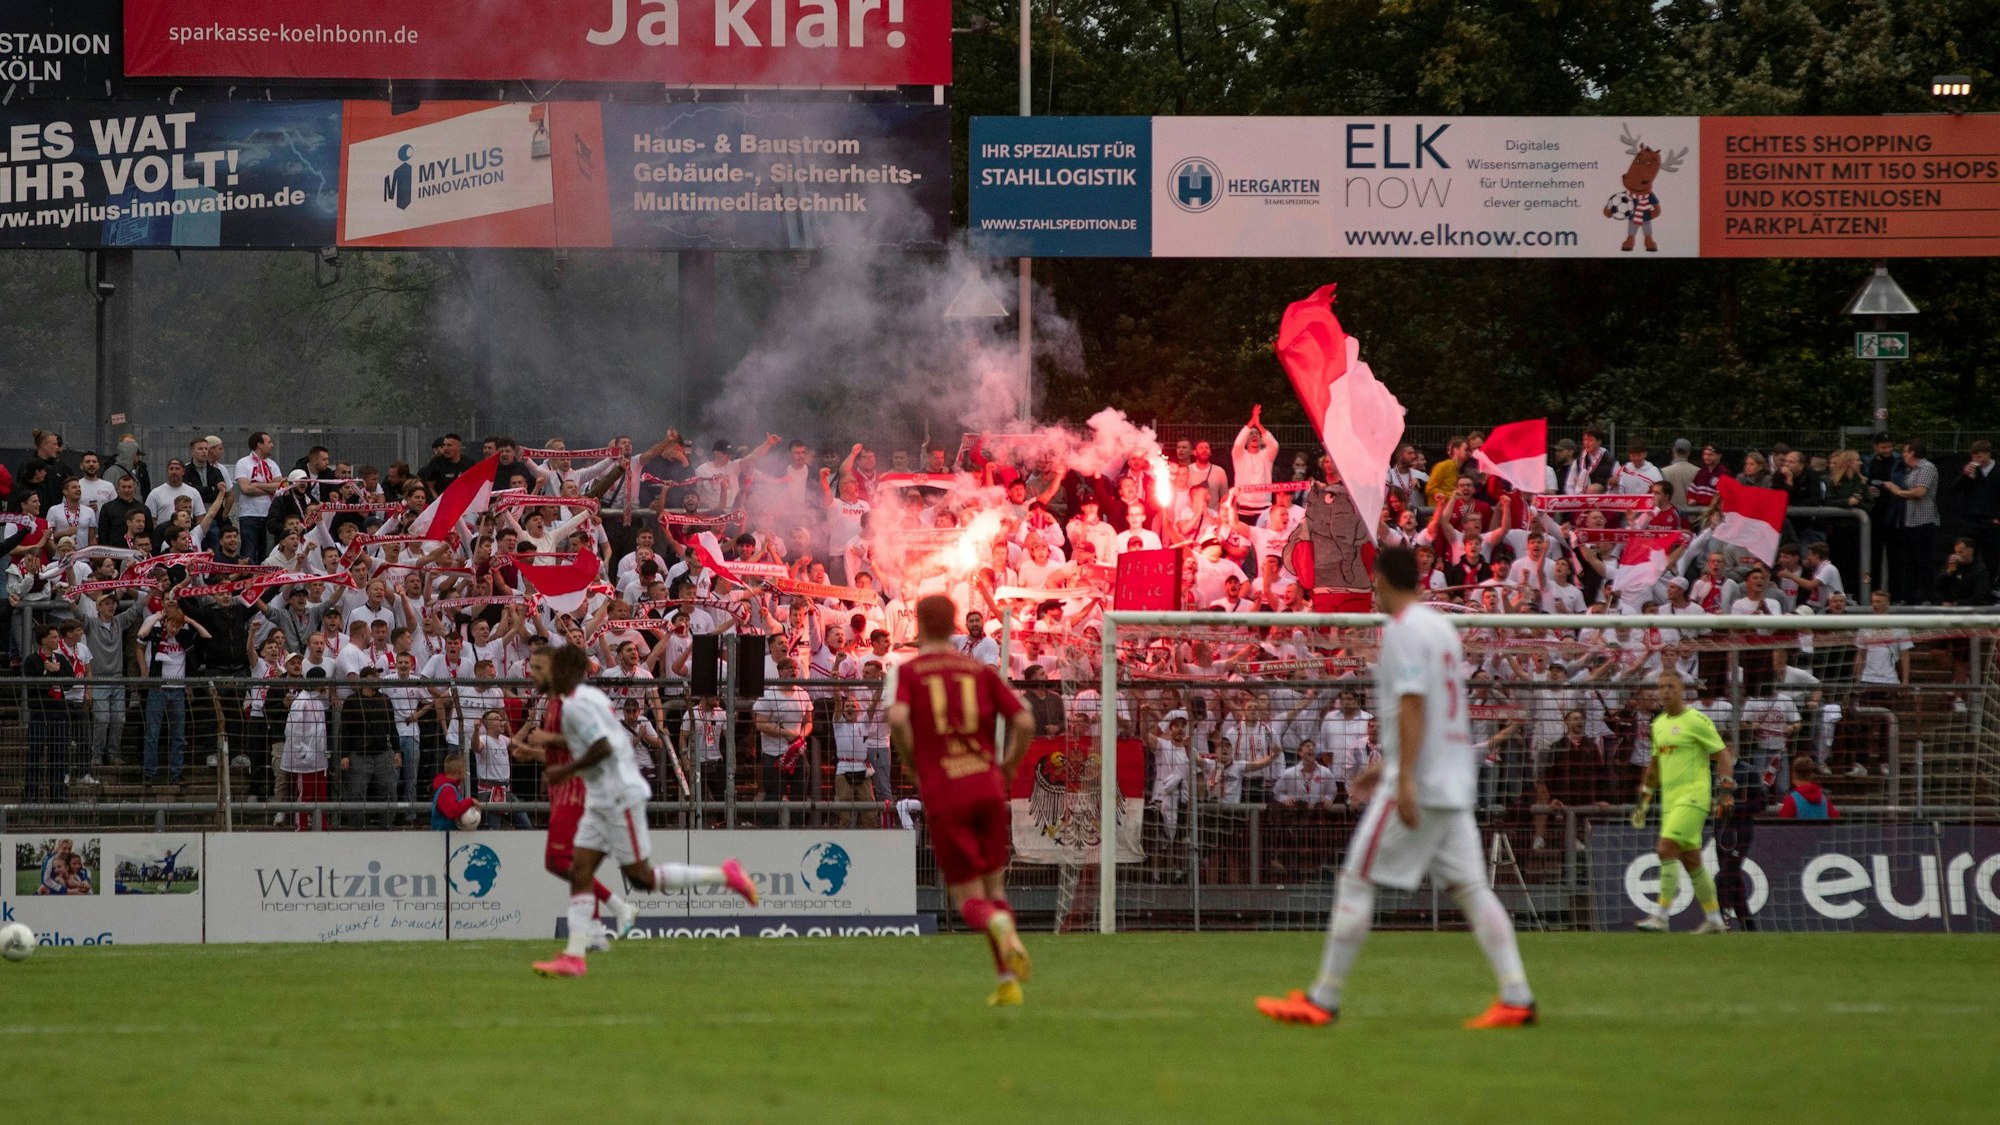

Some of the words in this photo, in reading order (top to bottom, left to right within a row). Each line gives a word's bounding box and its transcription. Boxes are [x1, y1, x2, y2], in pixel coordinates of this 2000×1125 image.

[169, 22, 419, 45] sparkasse-koelnbonn.de
[585, 0, 679, 46] Ja
[714, 0, 906, 48] klar!
[0, 33, 110, 55] STADION
[0, 121, 75, 163] ES
[89, 111, 196, 155] WAT
[634, 134, 705, 153] Haus-
[714, 134, 732, 153] &
[740, 134, 860, 153] Baustrom
[1346, 123, 1452, 169] ELK
[1506, 139, 1560, 153] Digitales
[1726, 135, 1807, 153] ECHTES
[1813, 134, 1932, 152] SHOPPING
[981, 144, 1011, 158] IHR
[1013, 144, 1100, 158] SPEZIALIST
[1104, 141, 1136, 158] FÜR
[419, 147, 504, 183] MYLIUS
[634, 162, 762, 186] Gebäude-,
[770, 163, 922, 184] Sicherheits-
[1466, 158, 1600, 172] Wissensmanagement
[1726, 162, 1826, 180] BEGINNT
[1832, 162, 1873, 180] MIT
[1879, 162, 1916, 179] 150
[1923, 161, 1999, 179] SHOPS
[0, 162, 86, 203] IHR
[100, 149, 239, 195] VOLT!
[418, 169, 504, 199] INNOVATION
[981, 168, 1137, 186] STAHLLOGISTIK
[1228, 179, 1320, 193] HERGARTEN
[1480, 177, 1497, 189] für
[1500, 177, 1585, 189] Unternehmen
[634, 192, 868, 212] Multimediatechnik
[1345, 176, 1452, 208] now
[1726, 190, 1775, 207] UND
[1782, 189, 1942, 207] KOSTENLOSEN
[0, 186, 306, 228] w.mylius-innovation.de
[1484, 197, 1520, 208] clever
[1524, 197, 1582, 211] gemacht.
[981, 219, 1137, 230] WWW.STAHLSPEDITION.DE
[1726, 213, 1888, 235] PARKPLÄTZEN!
[1344, 223, 1578, 247] www.elknow.com
[920, 672, 979, 735] 11
[255, 860, 437, 899] Weltzien
[261, 900, 385, 911] Internationale
[393, 899, 501, 911] Transporte
[390, 915, 444, 929] braucht
[33, 931, 75, 946] öln
